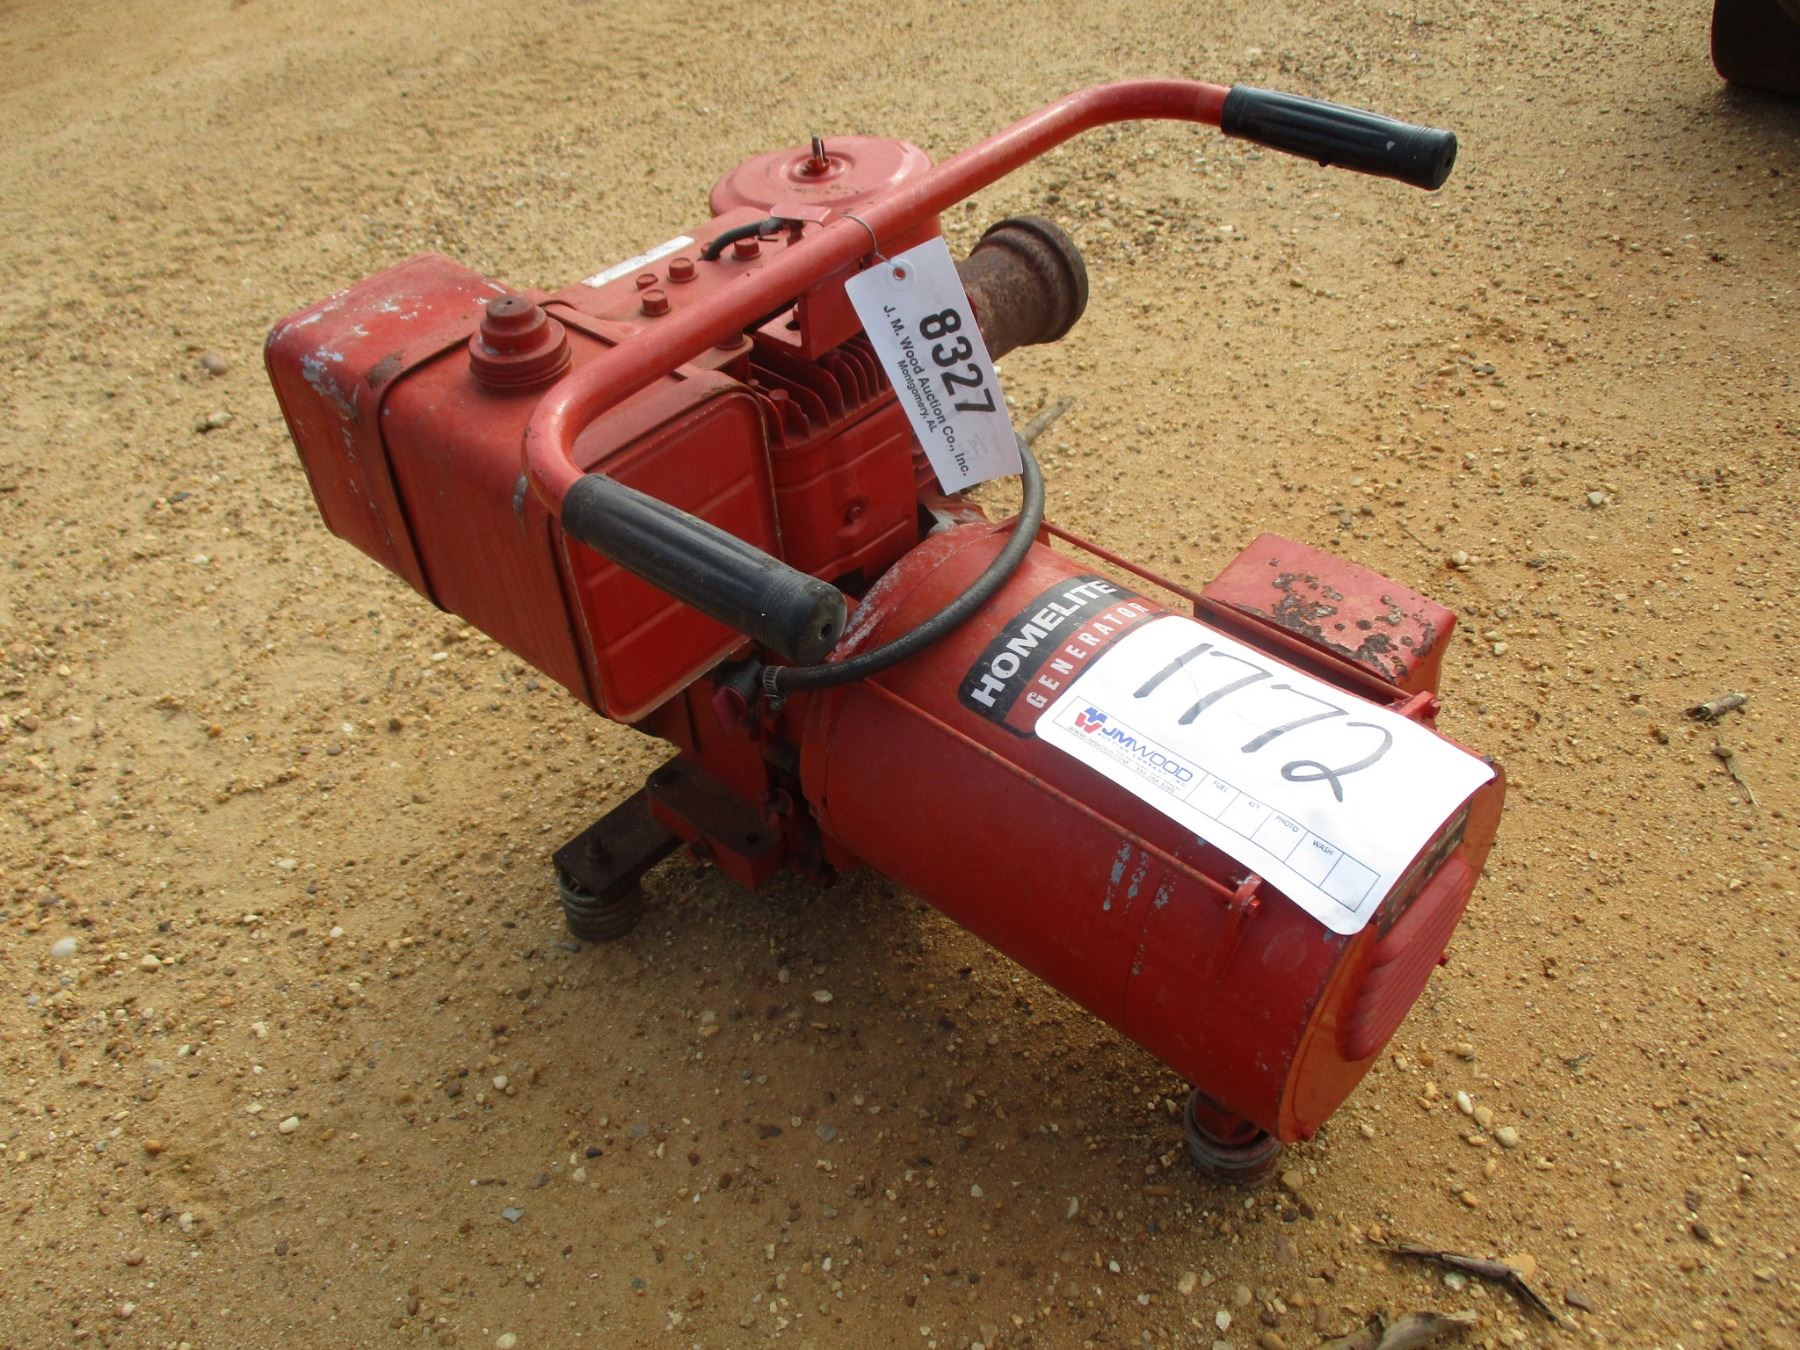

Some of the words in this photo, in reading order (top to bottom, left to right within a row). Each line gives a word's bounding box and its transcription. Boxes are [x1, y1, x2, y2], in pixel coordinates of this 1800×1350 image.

[884, 305, 895, 317] J.
[891, 319, 904, 336] M.
[900, 336, 925, 375] Wood
[918, 377, 946, 424] Auction
[942, 425, 955, 451] Co.,
[954, 452, 969, 476] Inc.
[897, 360, 929, 419] Montgomery,
[926, 420, 937, 433] AL
[920, 308, 996, 412] 8327
[971, 579, 1118, 708] HOMELITE
[1026, 602, 1149, 709] GENERATOR
[1101, 727, 1193, 782] JMWOOD
[1133, 643, 1393, 802] 1772
[1212, 780, 1228, 793] FUEL
[1275, 815, 1299, 833] PHOTO
[1312, 839, 1335, 856] WASH
